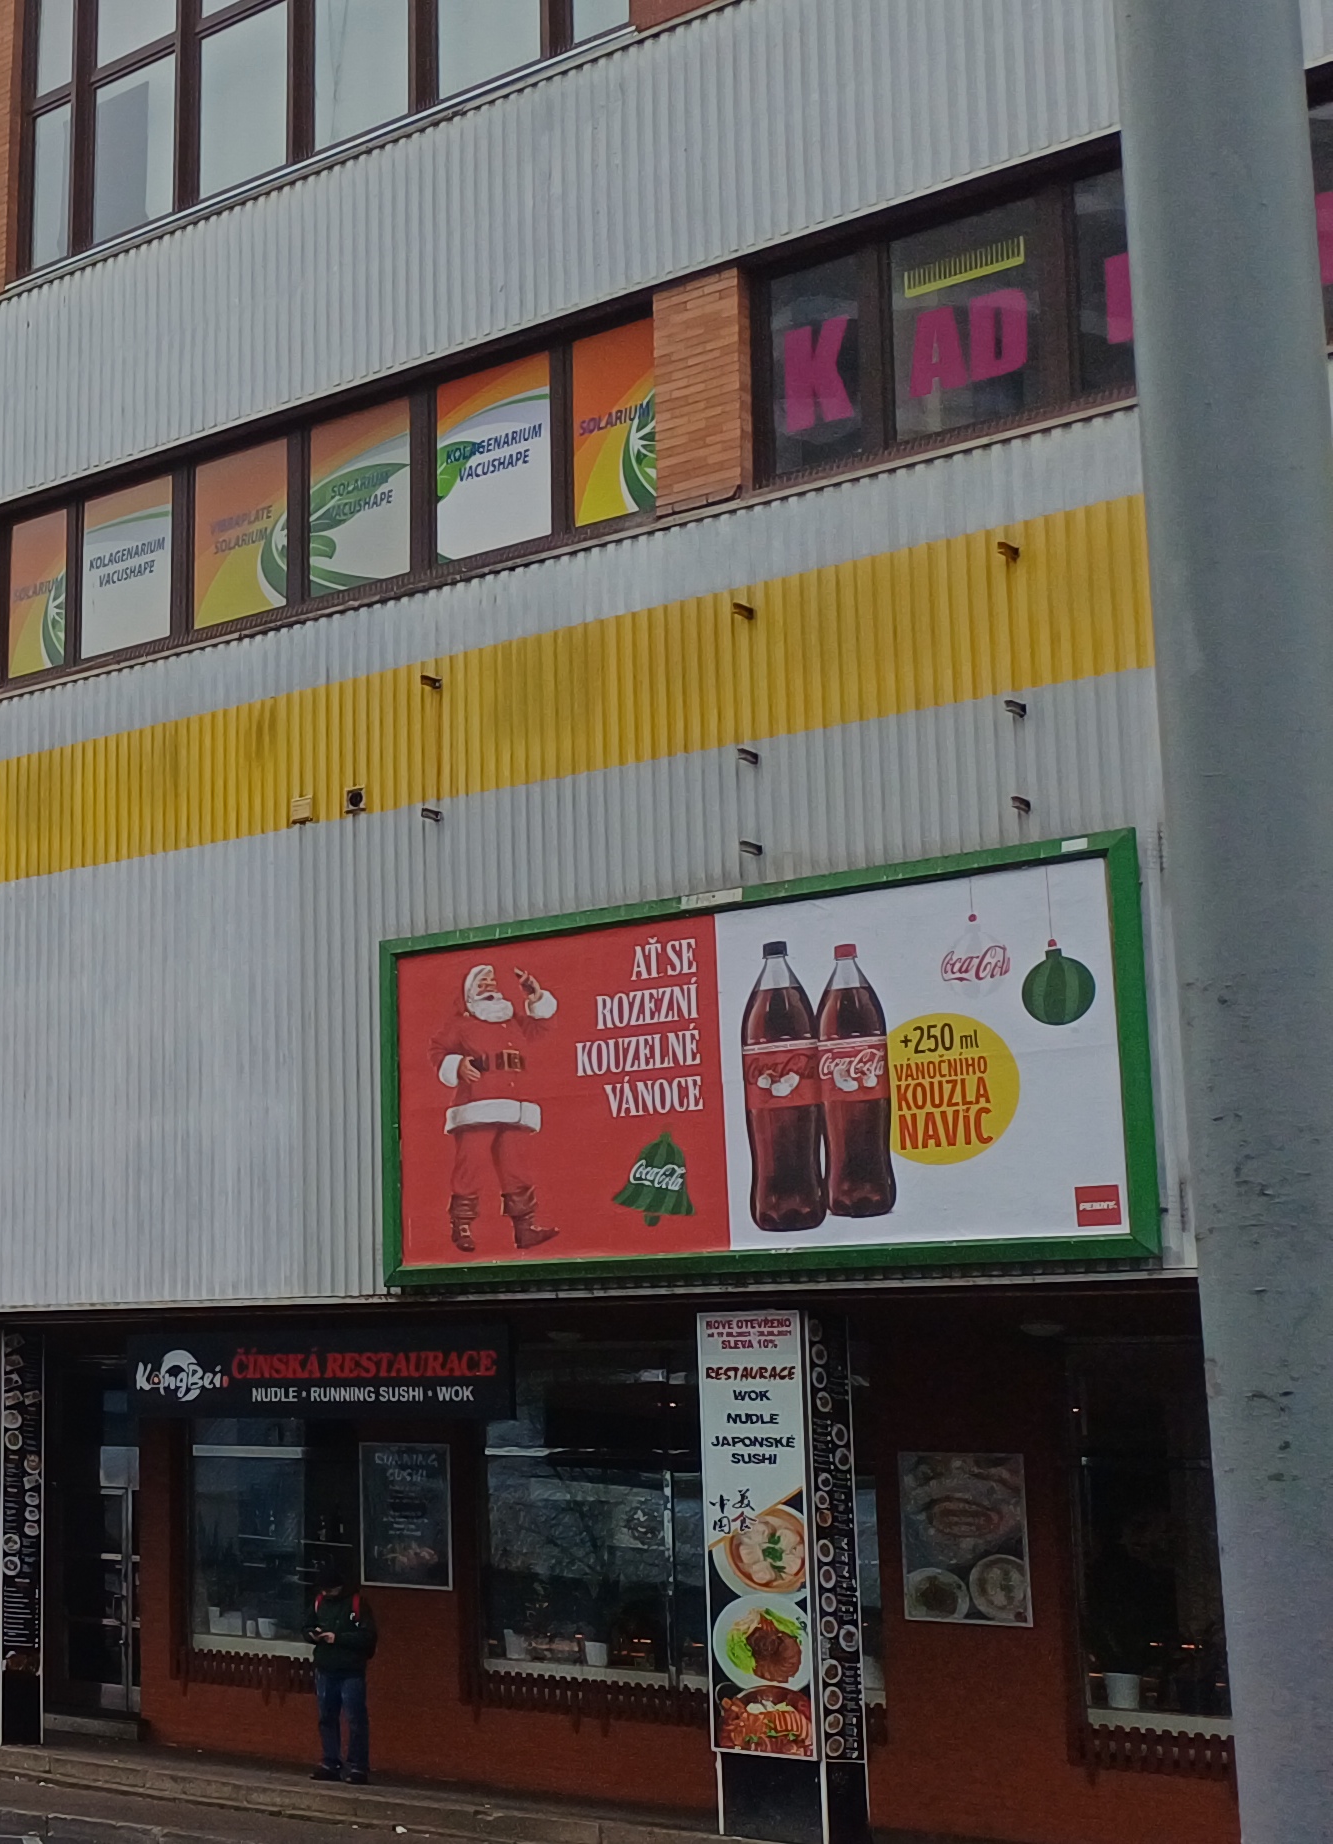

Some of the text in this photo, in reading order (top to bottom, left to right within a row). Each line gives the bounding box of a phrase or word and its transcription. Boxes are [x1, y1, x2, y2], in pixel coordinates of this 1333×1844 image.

[579, 400, 650, 436] SOLARIUM
[446, 423, 542, 465] KOLAGENARIUM
[458, 449, 530, 482] VACUSHAPE
[330, 471, 390, 499] SOLARIUM
[89, 537, 166, 572] KOLAGENARIUM
[214, 527, 268, 555] SOLARIUM
[99, 559, 155, 587] VACUSHAPE
[631, 937, 697, 981] AŤ SE
[596, 977, 698, 1030] ROZEZNÍ
[576, 1023, 701, 1076] KOUZELNÉ
[899, 1022, 954, 1055] +250
[959, 1029, 979, 1050] ml
[894, 1052, 988, 1082] VÁNOČNÍHO
[604, 1076, 703, 1118] VÁNOCE
[896, 1076, 991, 1112] KOUZLA
[898, 1106, 994, 1151] NAVÍC
[721, 1339, 778, 1350] SLEVA 10%
[232, 1347, 498, 1379] ČÍNSKÁ RESTAURACE
[705, 1365, 796, 1381] RESTAURACE
[251, 1385, 475, 1402] NUDLE RUNNING SUSHI WOK
[732, 1389, 772, 1402] WOK
[726, 1412, 780, 1425] NUDLE
[710, 1434, 796, 1448] JAPONSKÉ
[730, 1452, 778, 1465] SUSHI
